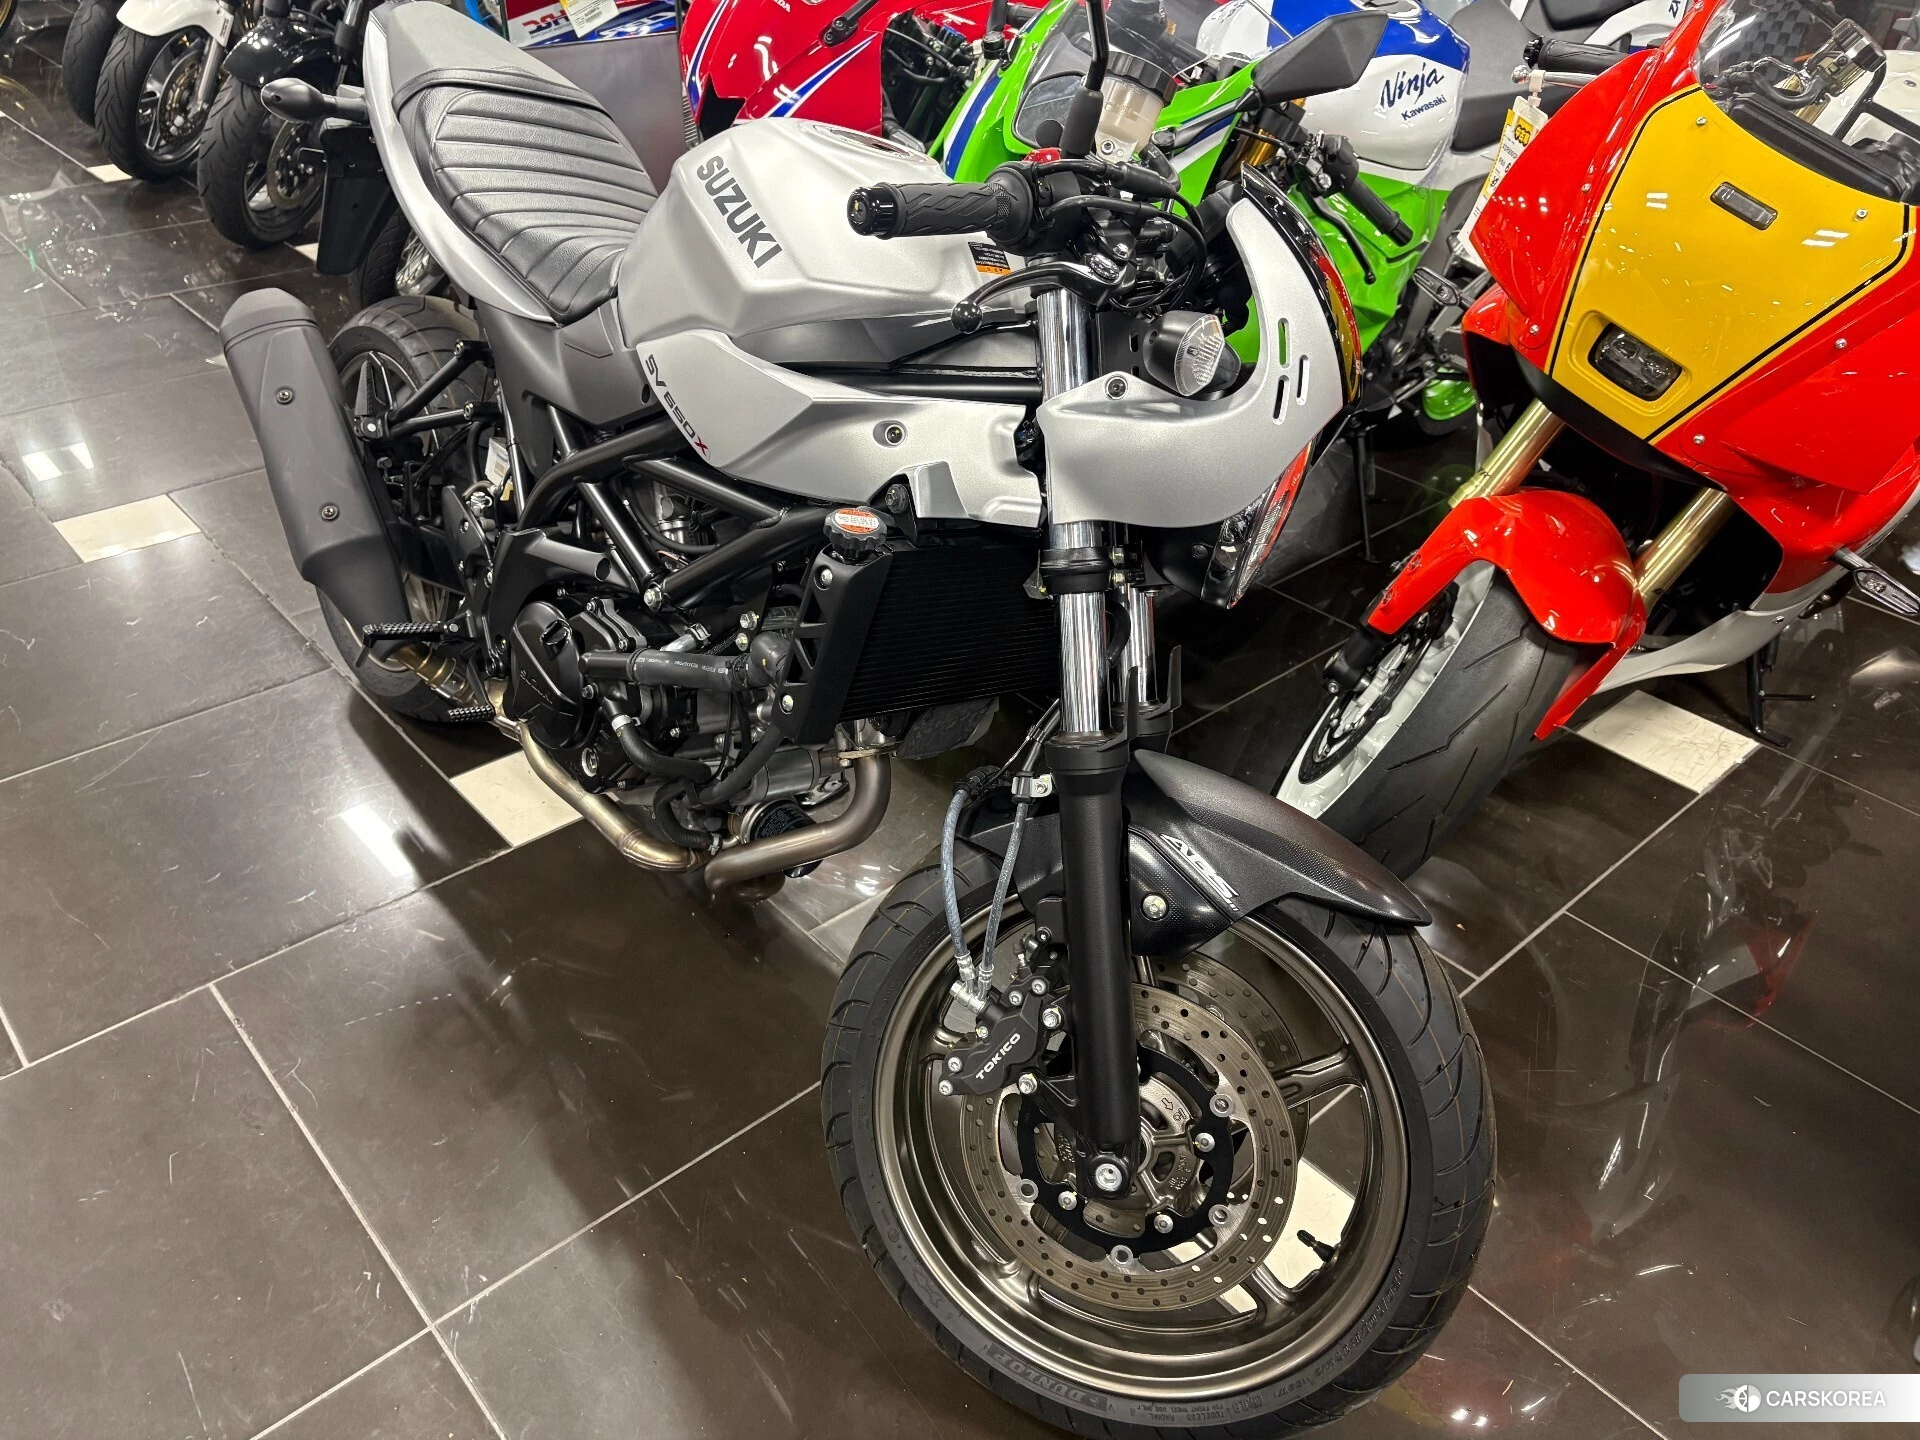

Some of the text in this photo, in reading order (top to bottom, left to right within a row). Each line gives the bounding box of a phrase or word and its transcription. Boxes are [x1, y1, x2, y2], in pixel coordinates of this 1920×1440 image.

[1380, 62, 1445, 109] Ninja
[1401, 94, 1447, 120] Kawasaki
[697, 156, 782, 268] SUZUKI
[1160, 834, 1239, 899] ABS
[975, 1033, 1021, 1080] TOKICO
[993, 1354, 1087, 1400] DUNLOP
